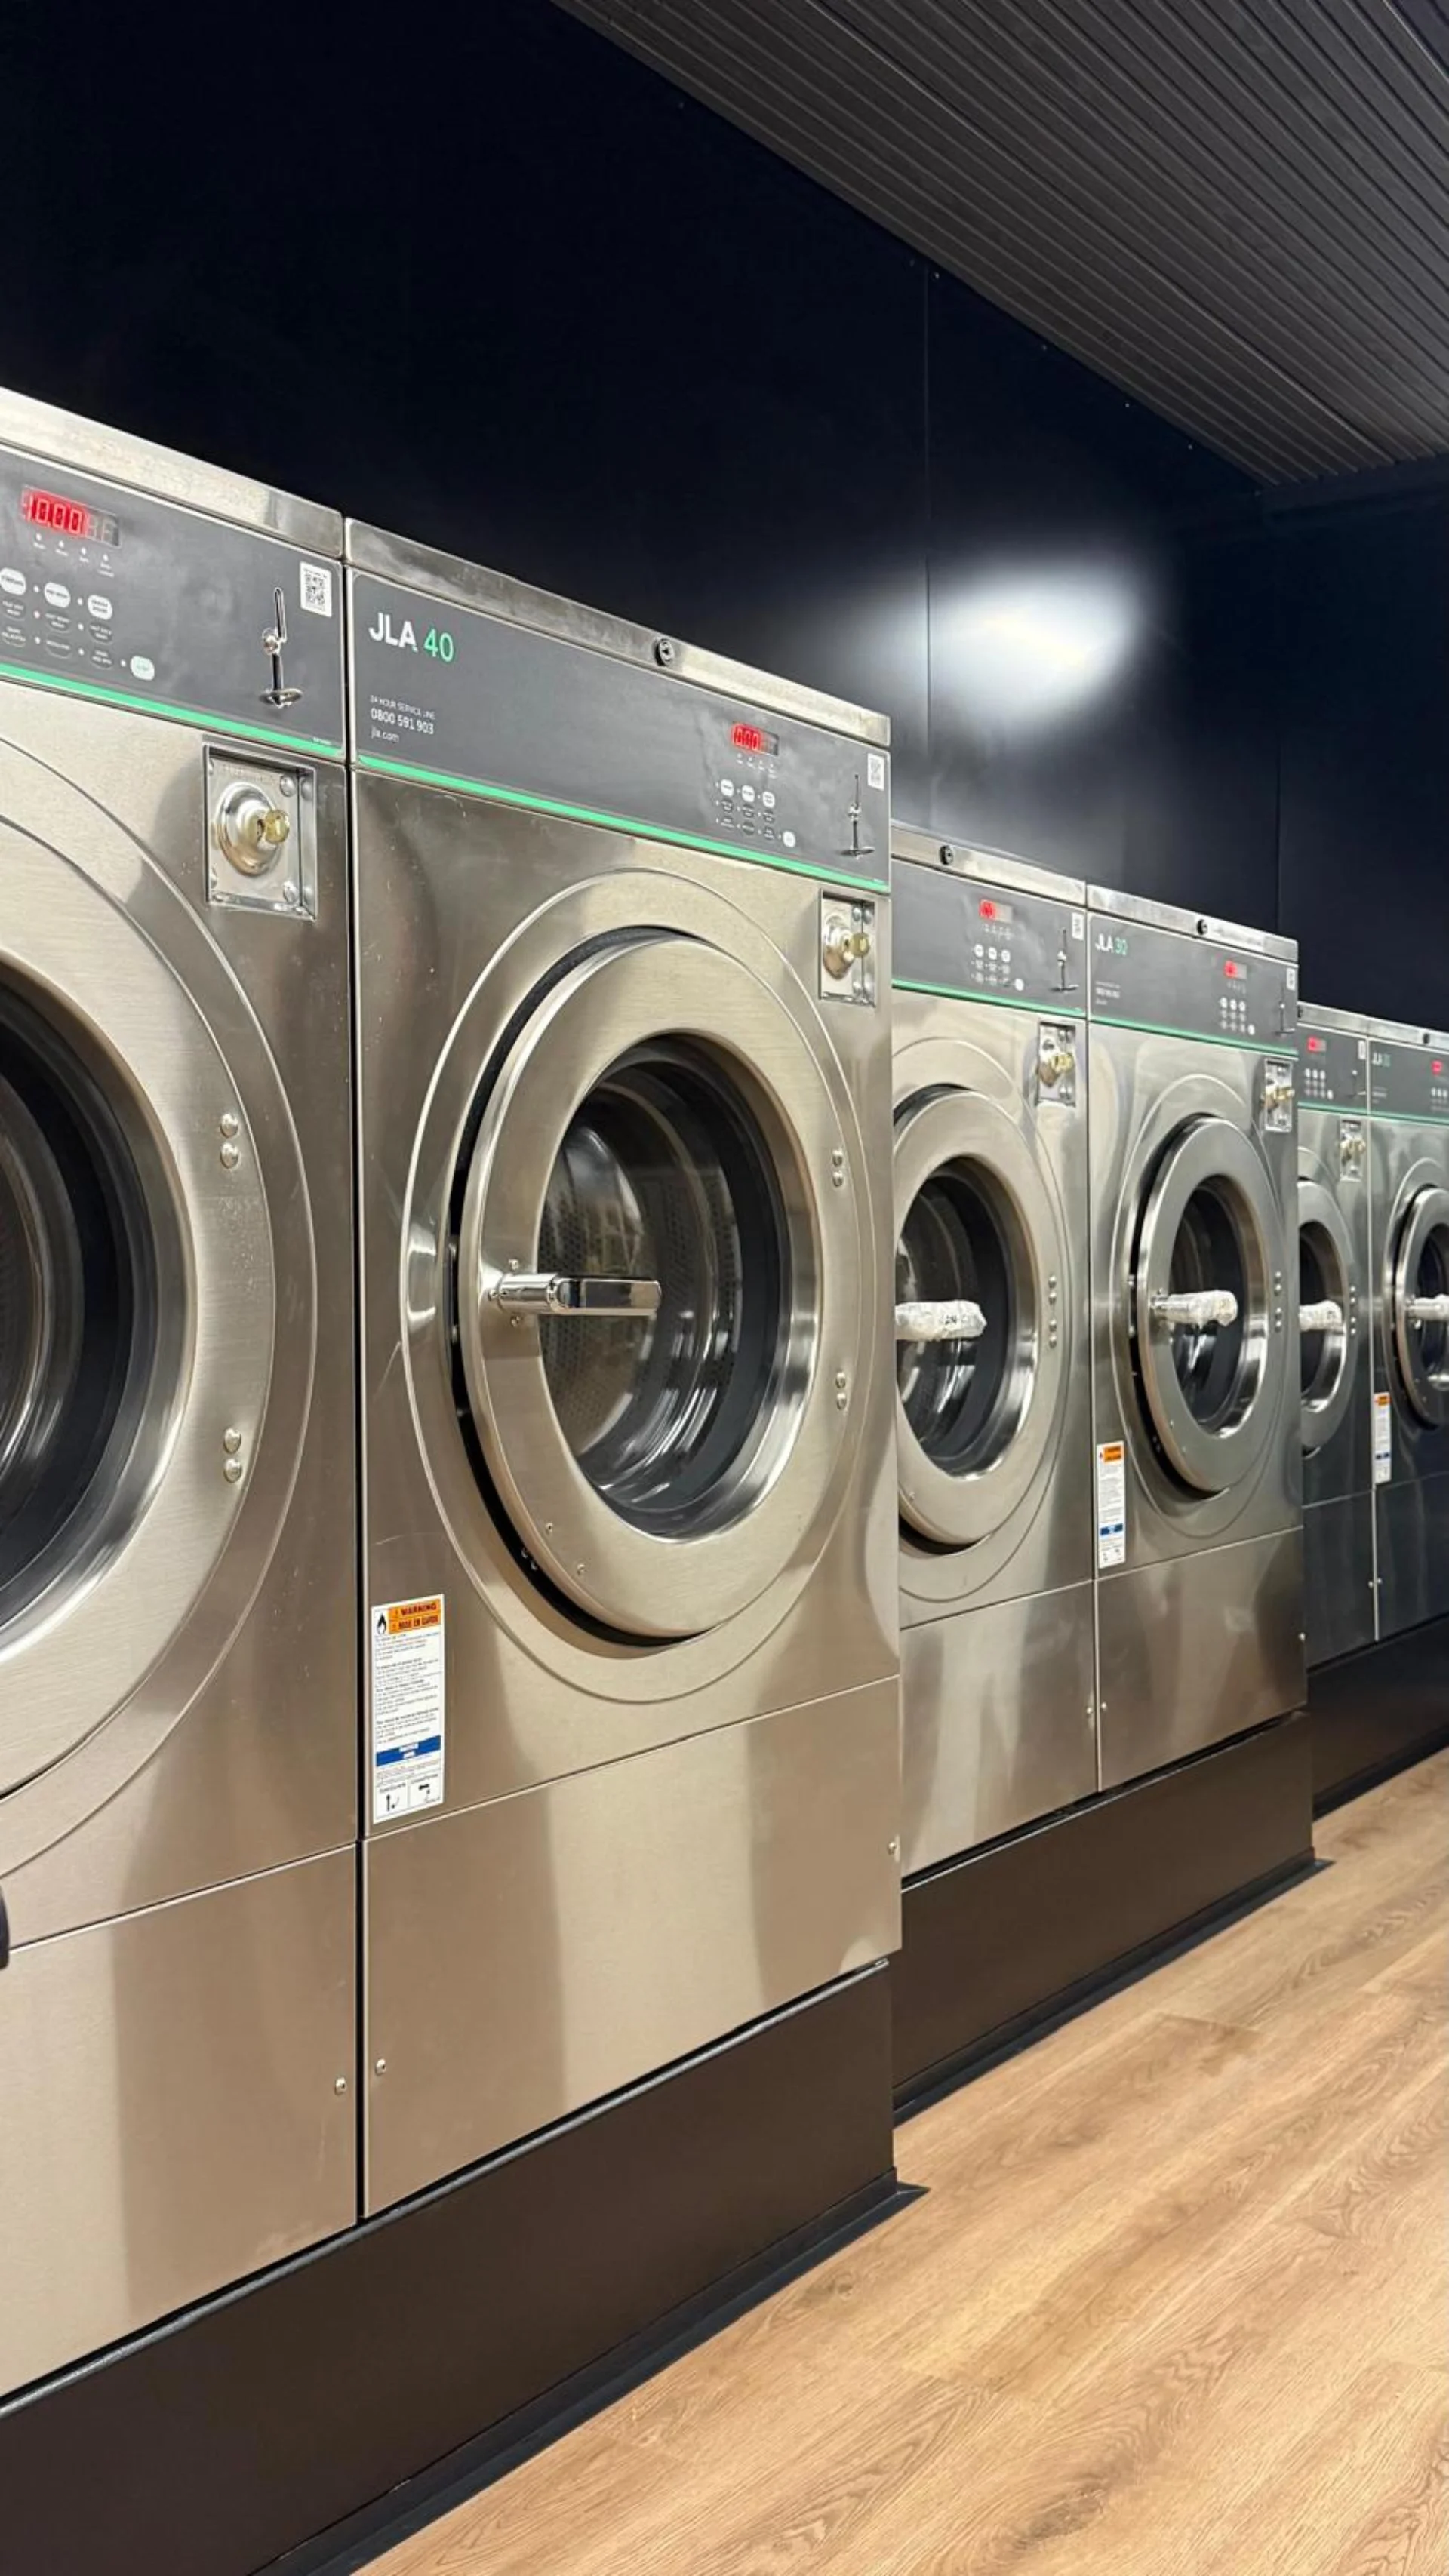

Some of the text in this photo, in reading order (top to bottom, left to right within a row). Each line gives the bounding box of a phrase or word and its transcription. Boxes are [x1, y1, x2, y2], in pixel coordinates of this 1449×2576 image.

[368, 613, 454, 662] JLA 40
[371, 708, 434, 735] 0800 591 903
[371, 726, 400, 742] jla.com
[1095, 933, 1114, 954] JLA
